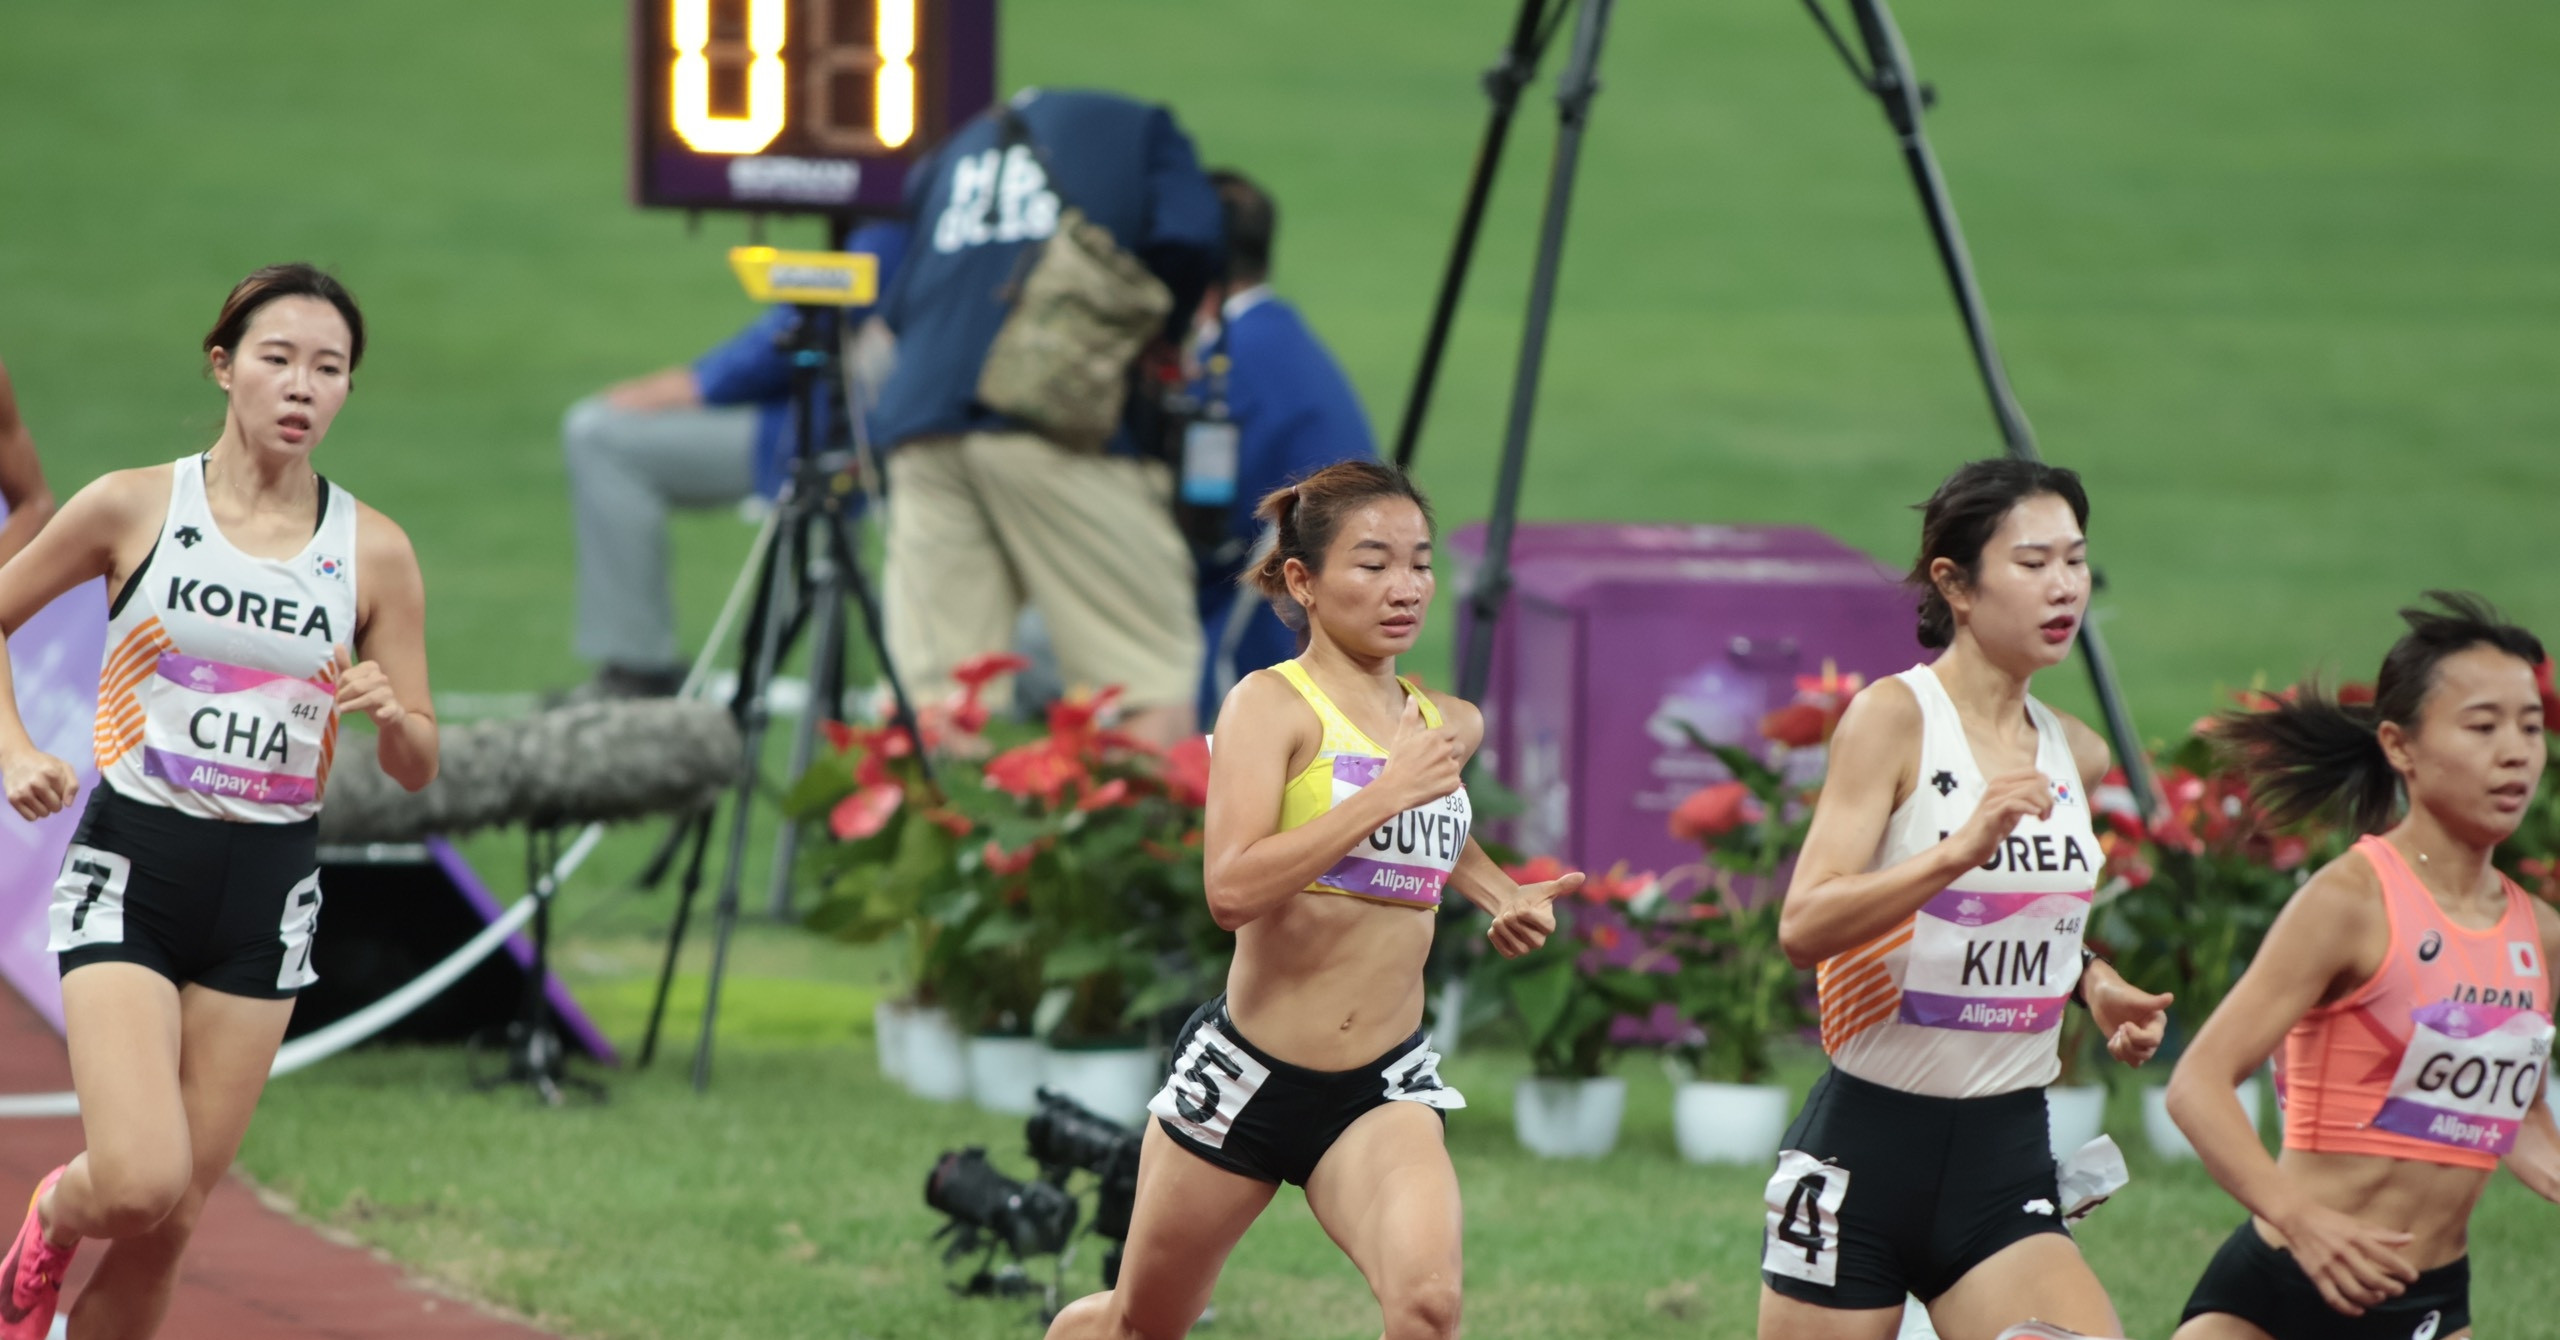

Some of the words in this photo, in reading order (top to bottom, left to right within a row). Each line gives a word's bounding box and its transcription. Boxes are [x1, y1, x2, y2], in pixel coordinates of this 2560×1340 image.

[166, 576, 333, 643] KOREA
[188, 706, 289, 764] CHA
[291, 703, 319, 721] 441
[1444, 795, 1465, 814] 938
[1357, 809, 1467, 862] GUYEN
[1939, 830, 2089, 872] REA
[71, 858, 112, 932] 7
[2054, 917, 2081, 935] 448
[1960, 940, 2050, 986] KIM
[1174, 1040, 1244, 1125] 5
[1778, 1173, 1826, 1265] 4
